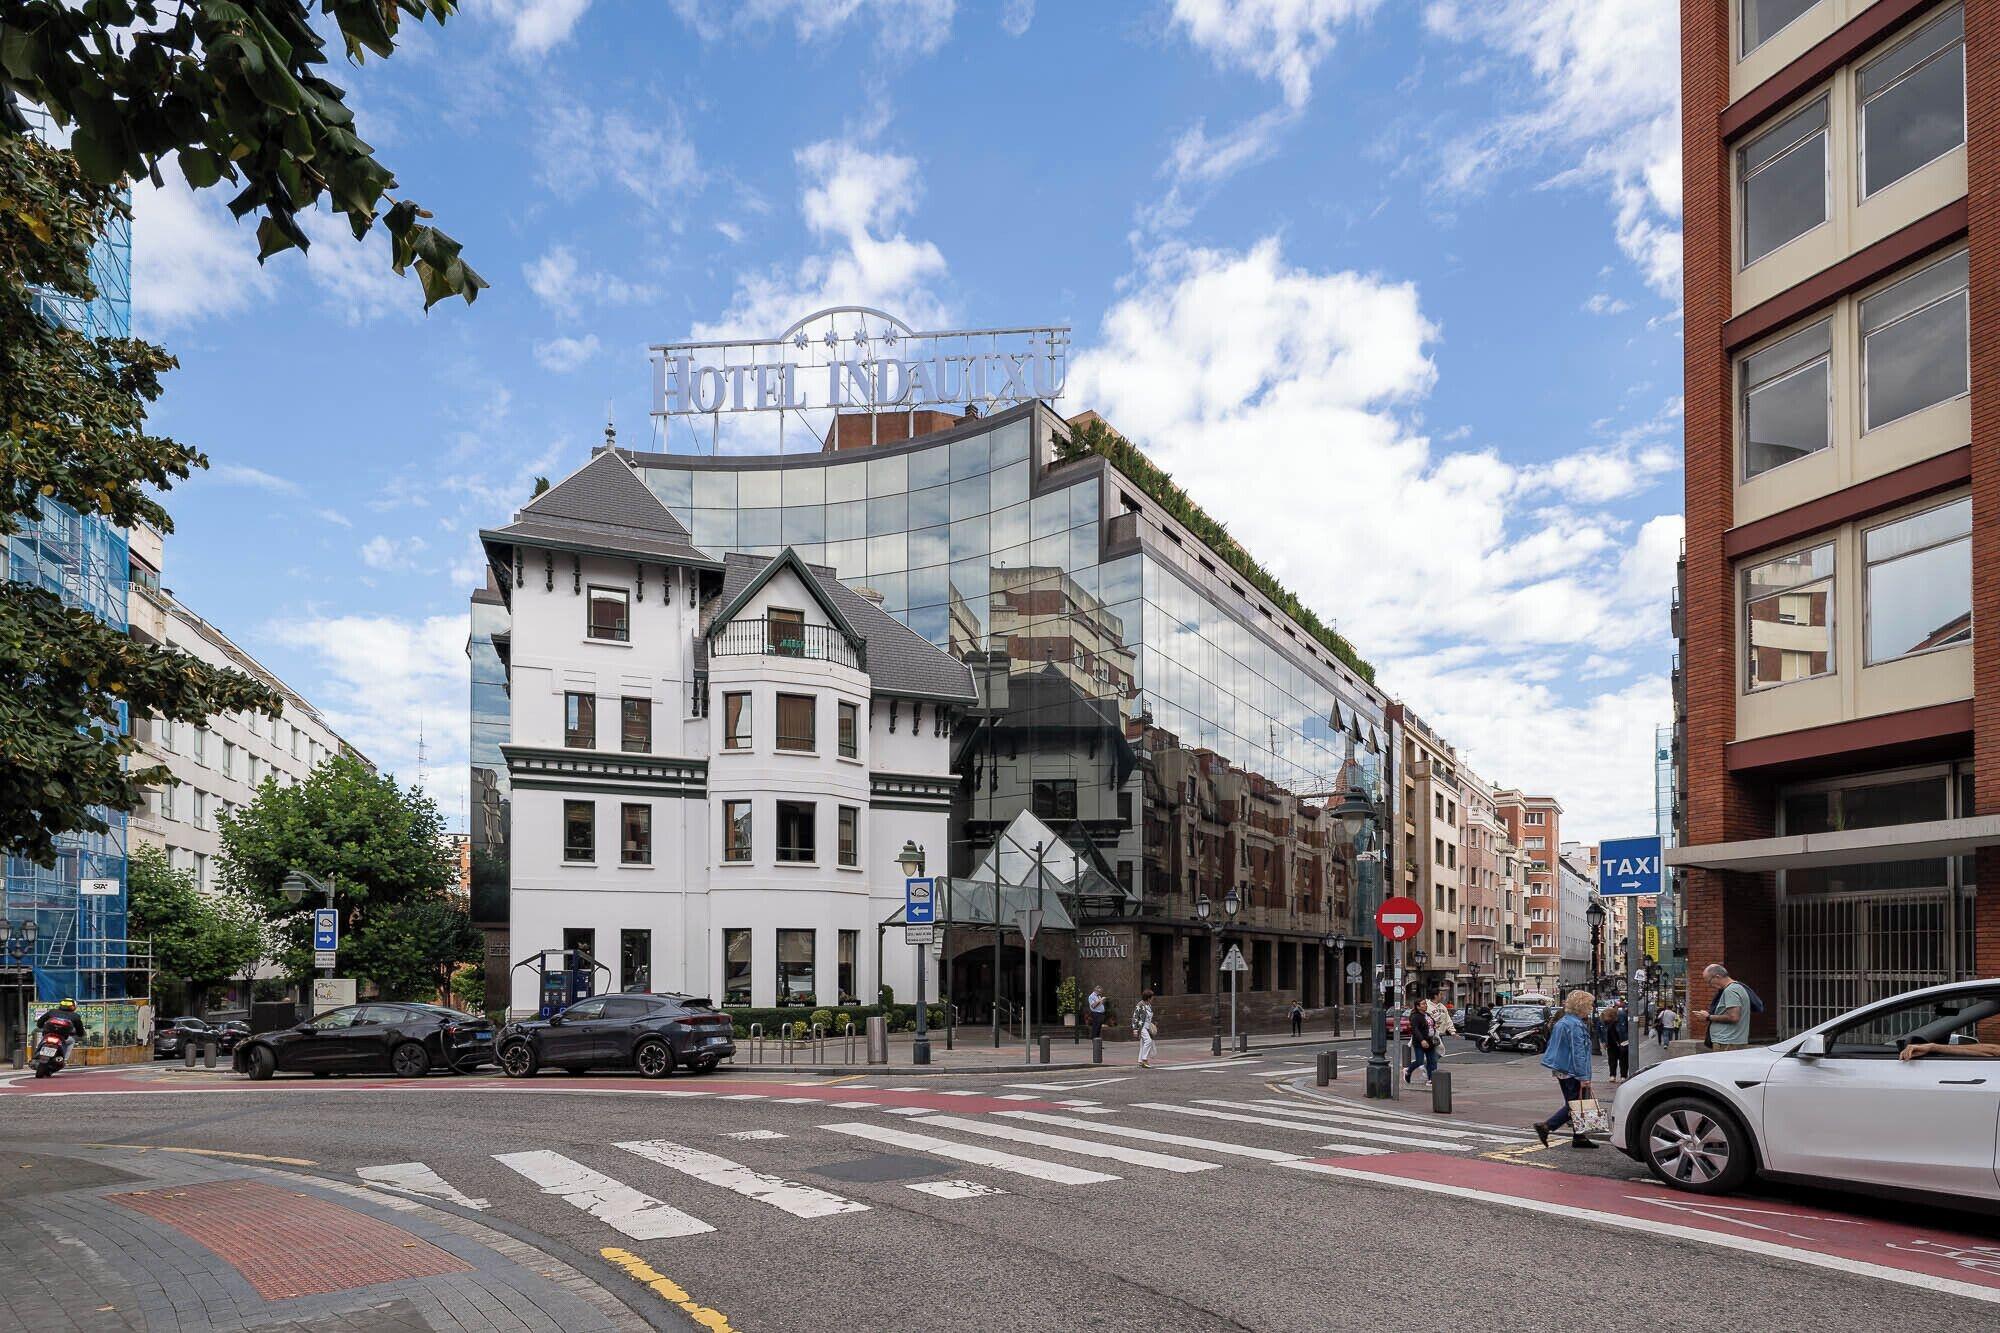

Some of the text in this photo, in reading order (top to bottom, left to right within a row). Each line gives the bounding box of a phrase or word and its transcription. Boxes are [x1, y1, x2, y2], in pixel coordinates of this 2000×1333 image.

[650, 338, 1070, 415] HOTEL INDAUTXU
[1602, 856, 1659, 877] TAXI
[1084, 935, 1118, 947] HOTEL
[1079, 944, 1128, 958] NDAUTXU
